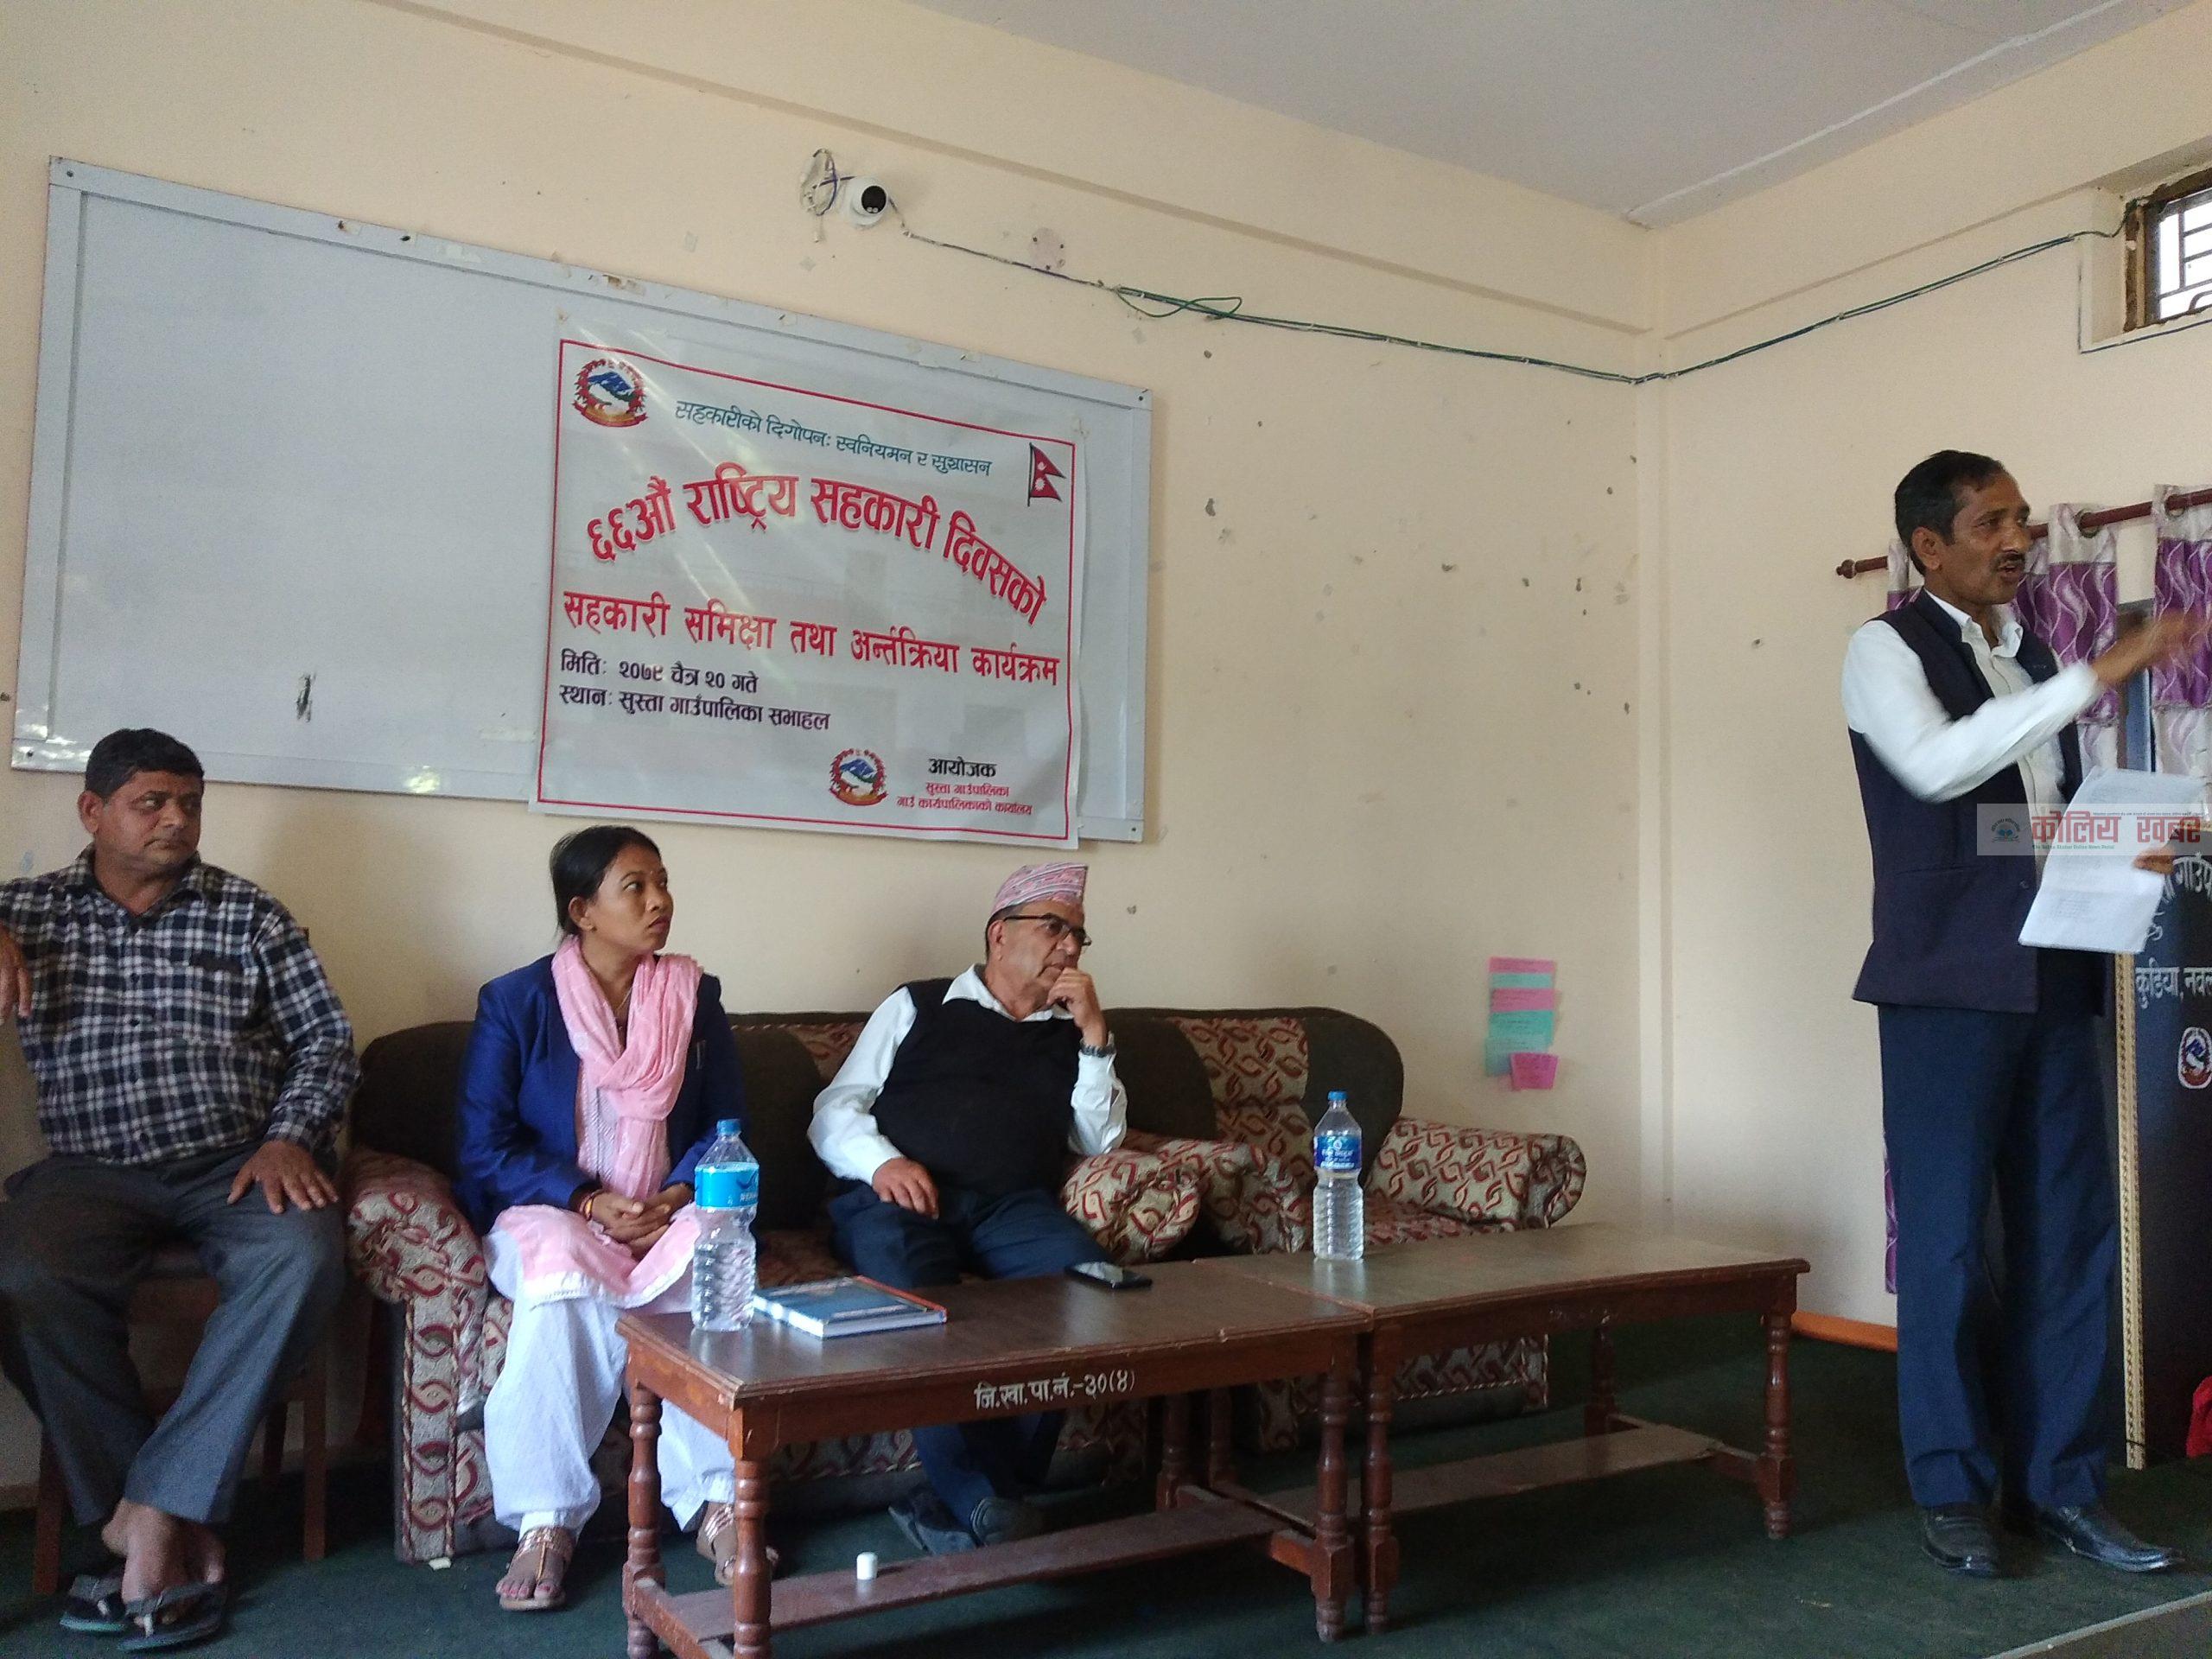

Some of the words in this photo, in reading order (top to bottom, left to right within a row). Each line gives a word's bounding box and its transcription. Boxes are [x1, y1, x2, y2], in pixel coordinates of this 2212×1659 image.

[675, 400, 762, 433] सहकारीको
[836, 434, 912, 465] स्वनियमन
[916, 451, 928, 467] र
[683, 461, 799, 531] राष्ट्रिय
[810, 476, 940, 550] सहकारी
[942, 510, 1047, 626] दिवसको
[563, 591, 671, 639] सहकारी
[684, 598, 777, 650] समिक्षा
[790, 620, 838, 656] तथा
[970, 642, 1060, 685] कार्यक्रम
[671, 660, 700, 686] चैत्र
[705, 671, 725, 689] २०
[732, 671, 759, 692] गते
[619, 690, 664, 714] सुस्ता
[670, 694, 763, 721] गाउँपालिका
[768, 707, 830, 730] सभाहल
[928, 756, 997, 777] आयोजक
